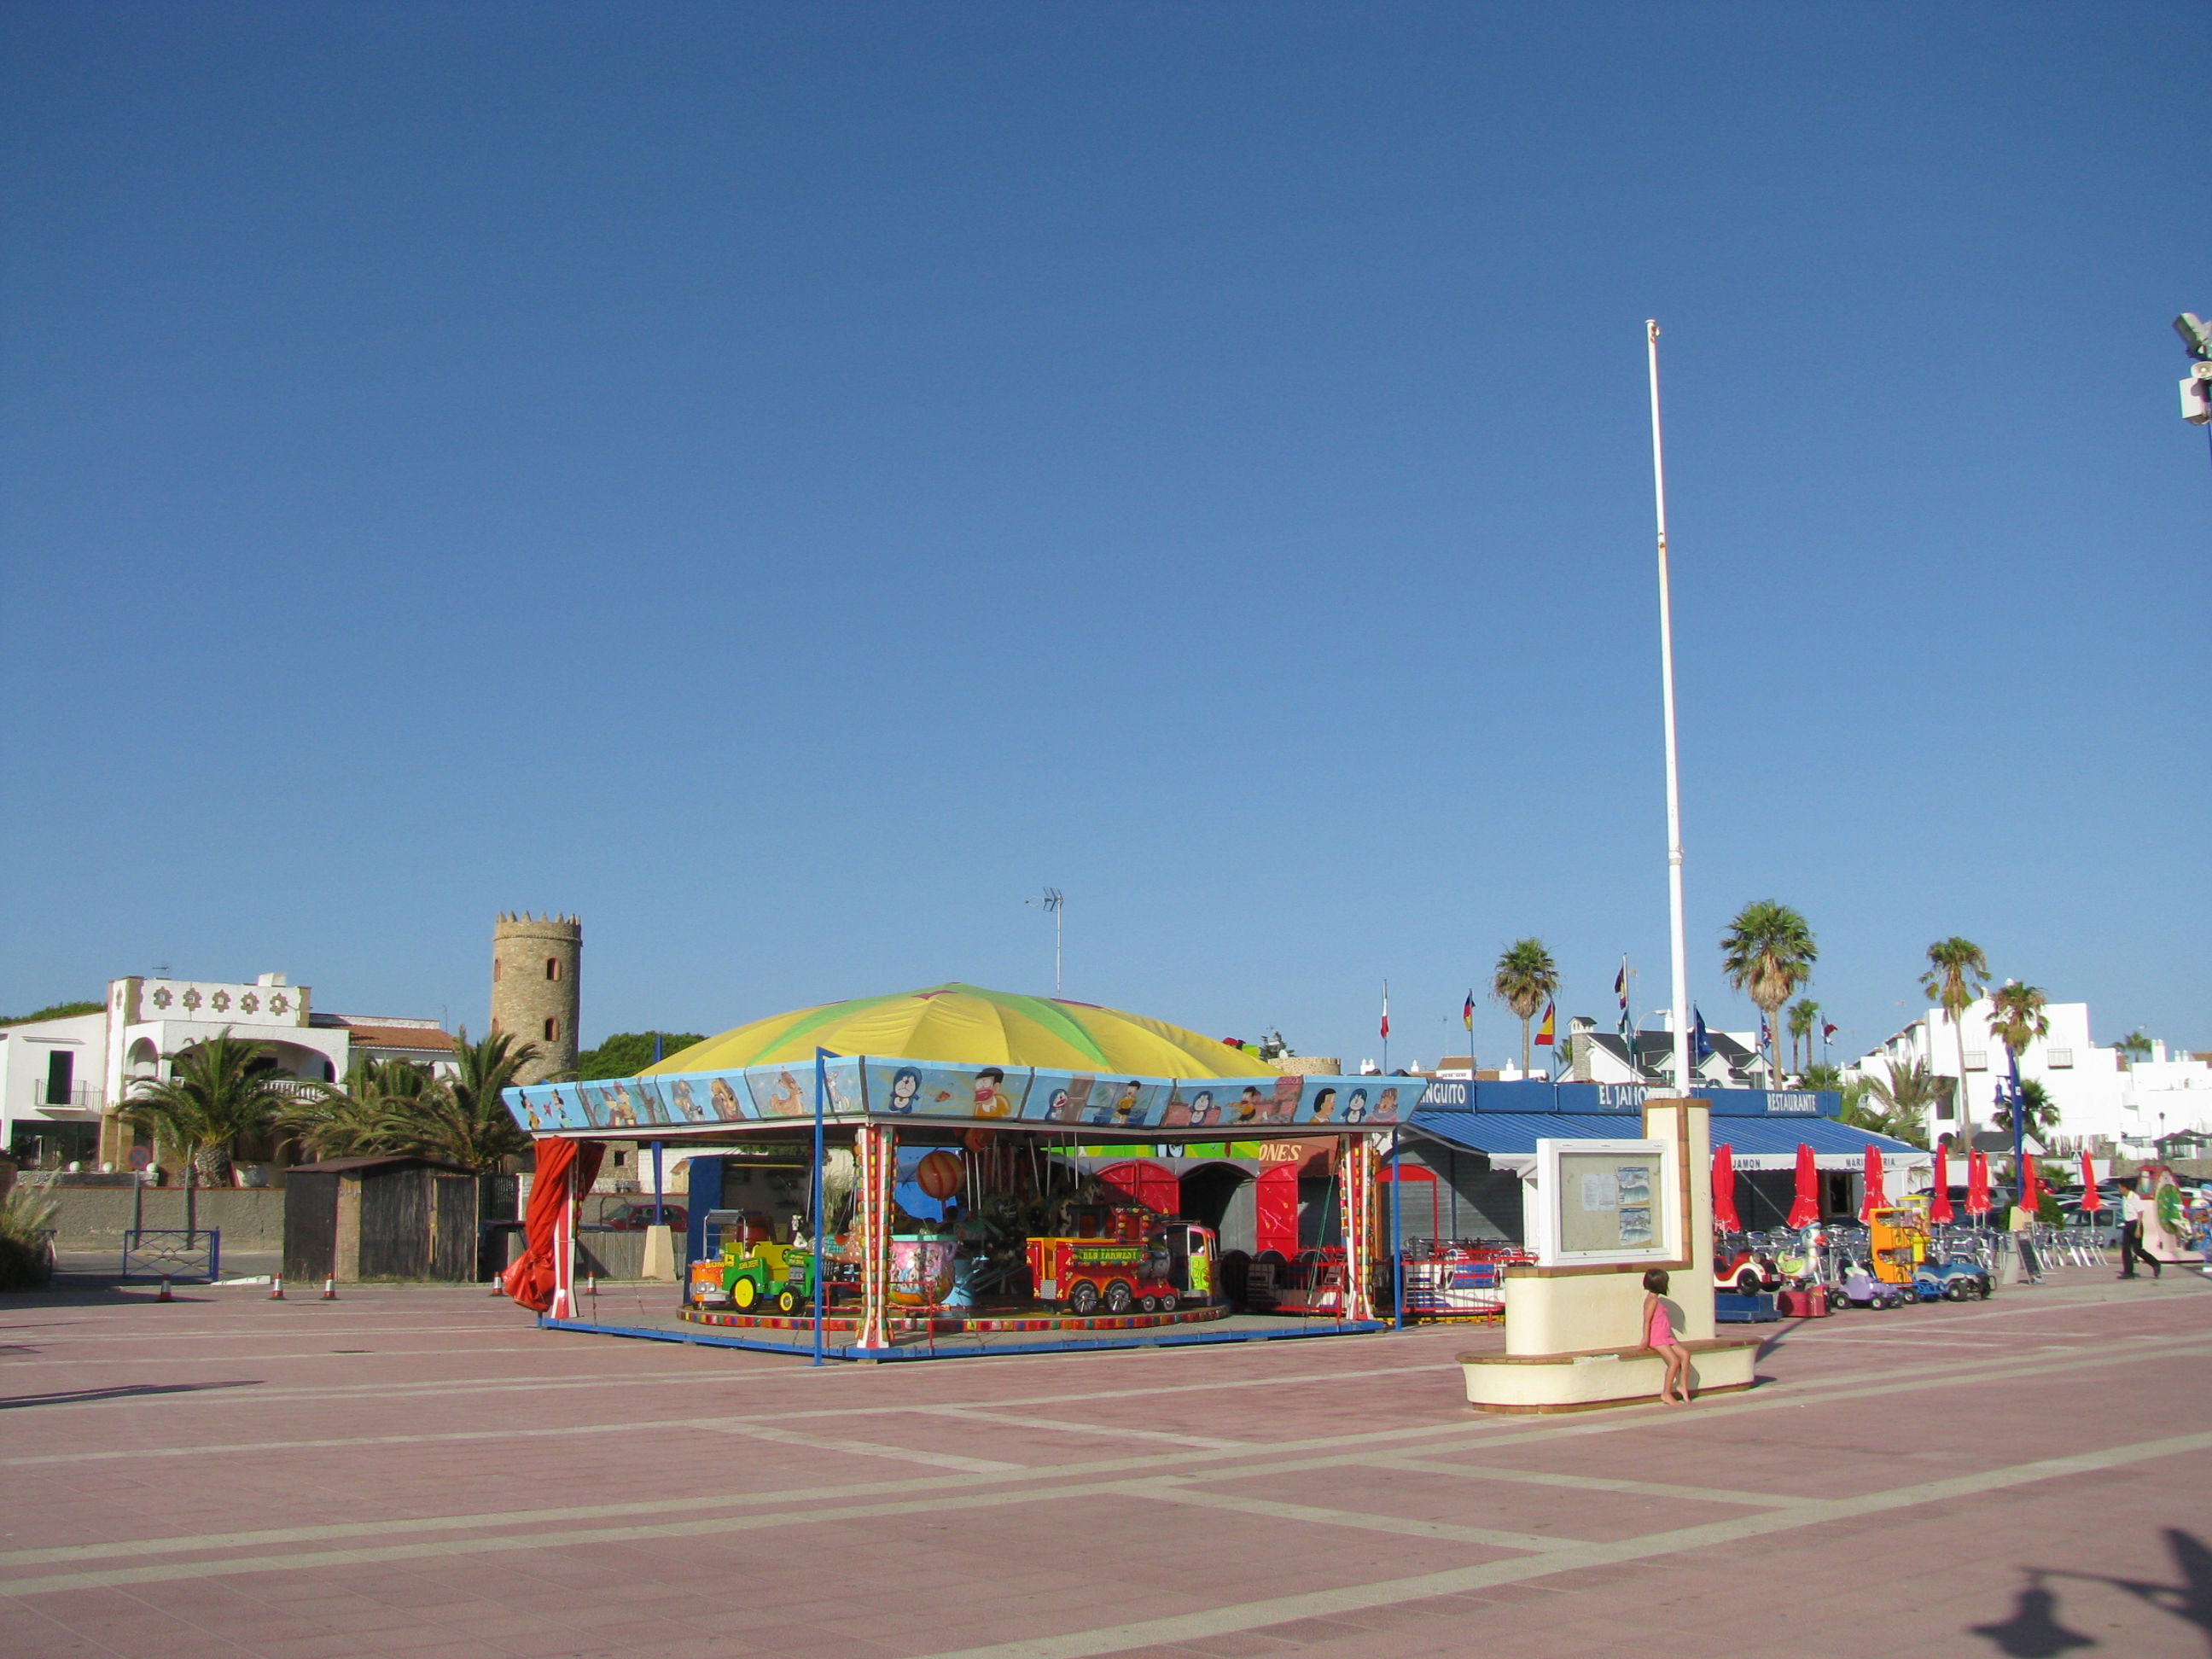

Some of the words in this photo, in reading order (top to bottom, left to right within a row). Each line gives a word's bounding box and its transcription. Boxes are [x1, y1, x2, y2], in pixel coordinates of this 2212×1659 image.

[1598, 1085, 1612, 1105] EL
[1615, 1085, 1648, 1109] JAMO
[1767, 1092, 1816, 1112] RESTAURANTE
[1733, 1159, 1761, 1168] JAMON
